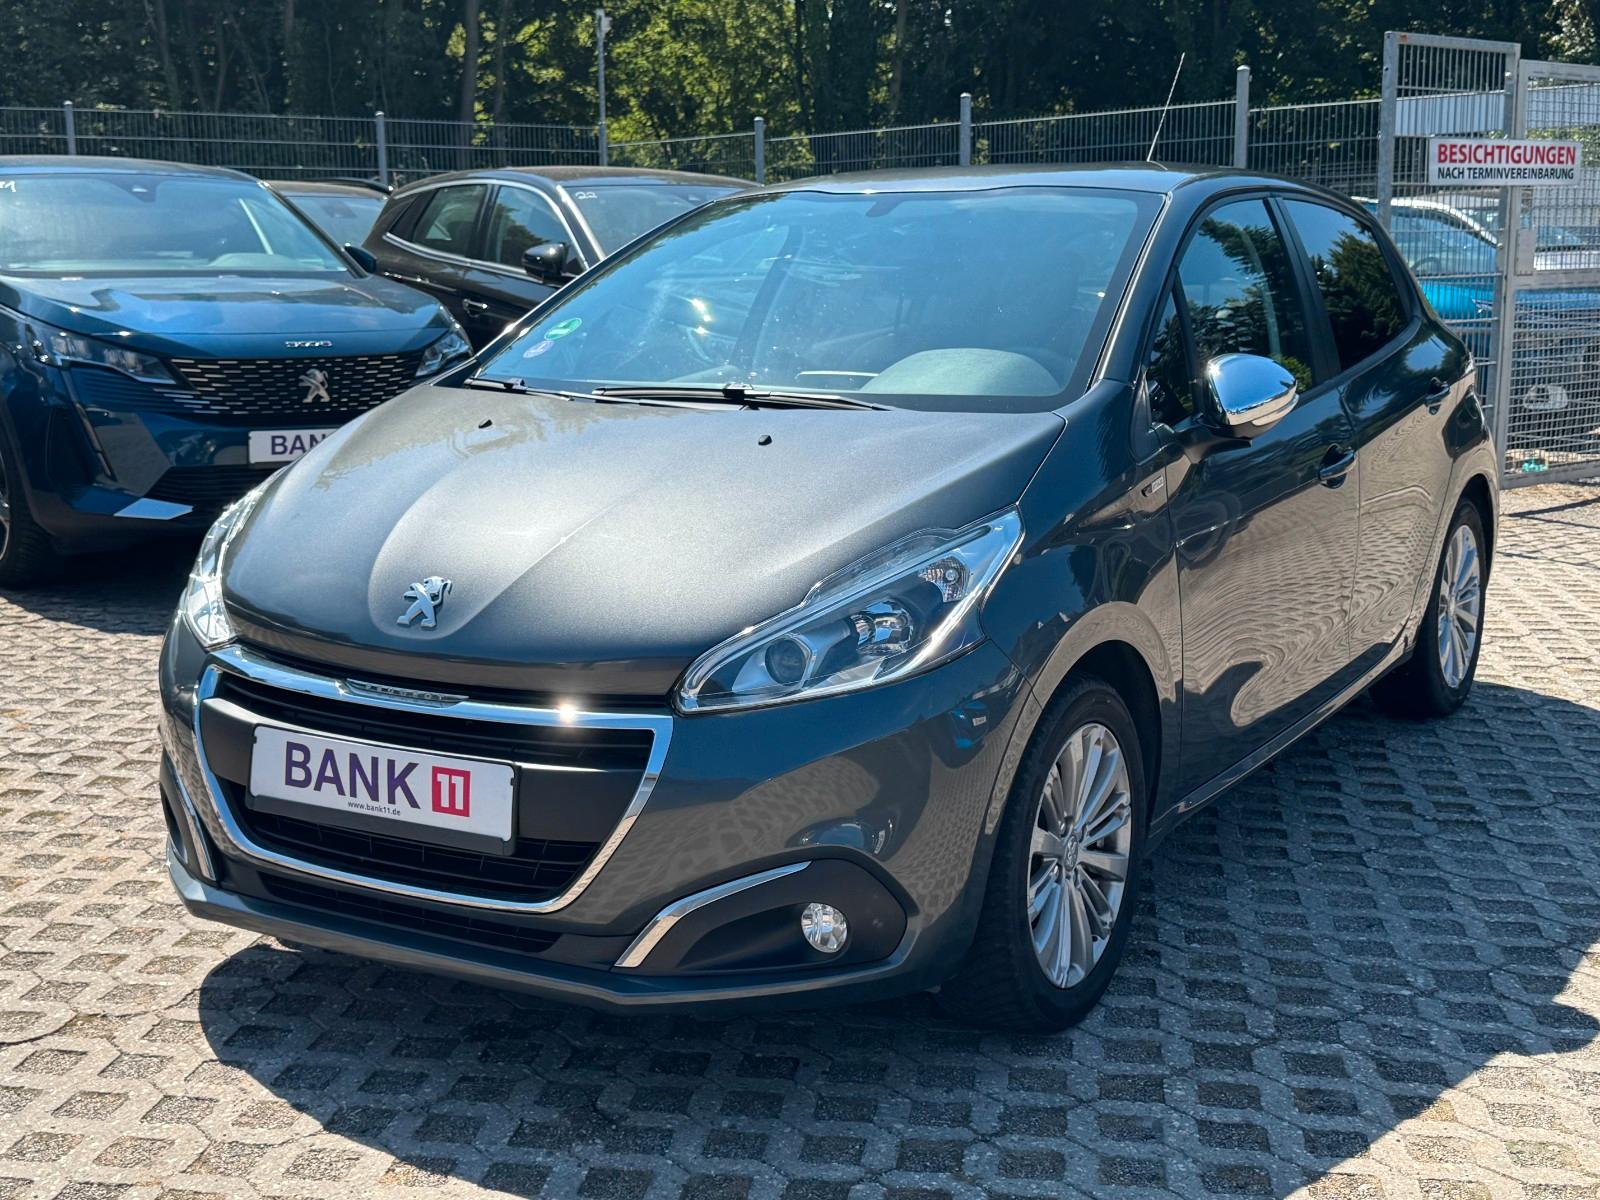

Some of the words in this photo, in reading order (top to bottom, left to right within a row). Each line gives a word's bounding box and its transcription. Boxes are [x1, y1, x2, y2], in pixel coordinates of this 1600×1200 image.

[1437, 143, 1576, 165] BESICHTIGUNGEN
[1437, 167, 1465, 179] NACH
[1467, 167, 1574, 180] TERMINVEREINBARUNG
[285, 741, 421, 809] BANK
[437, 773, 465, 811] 11
[347, 801, 401, 816] www.bank11.de
